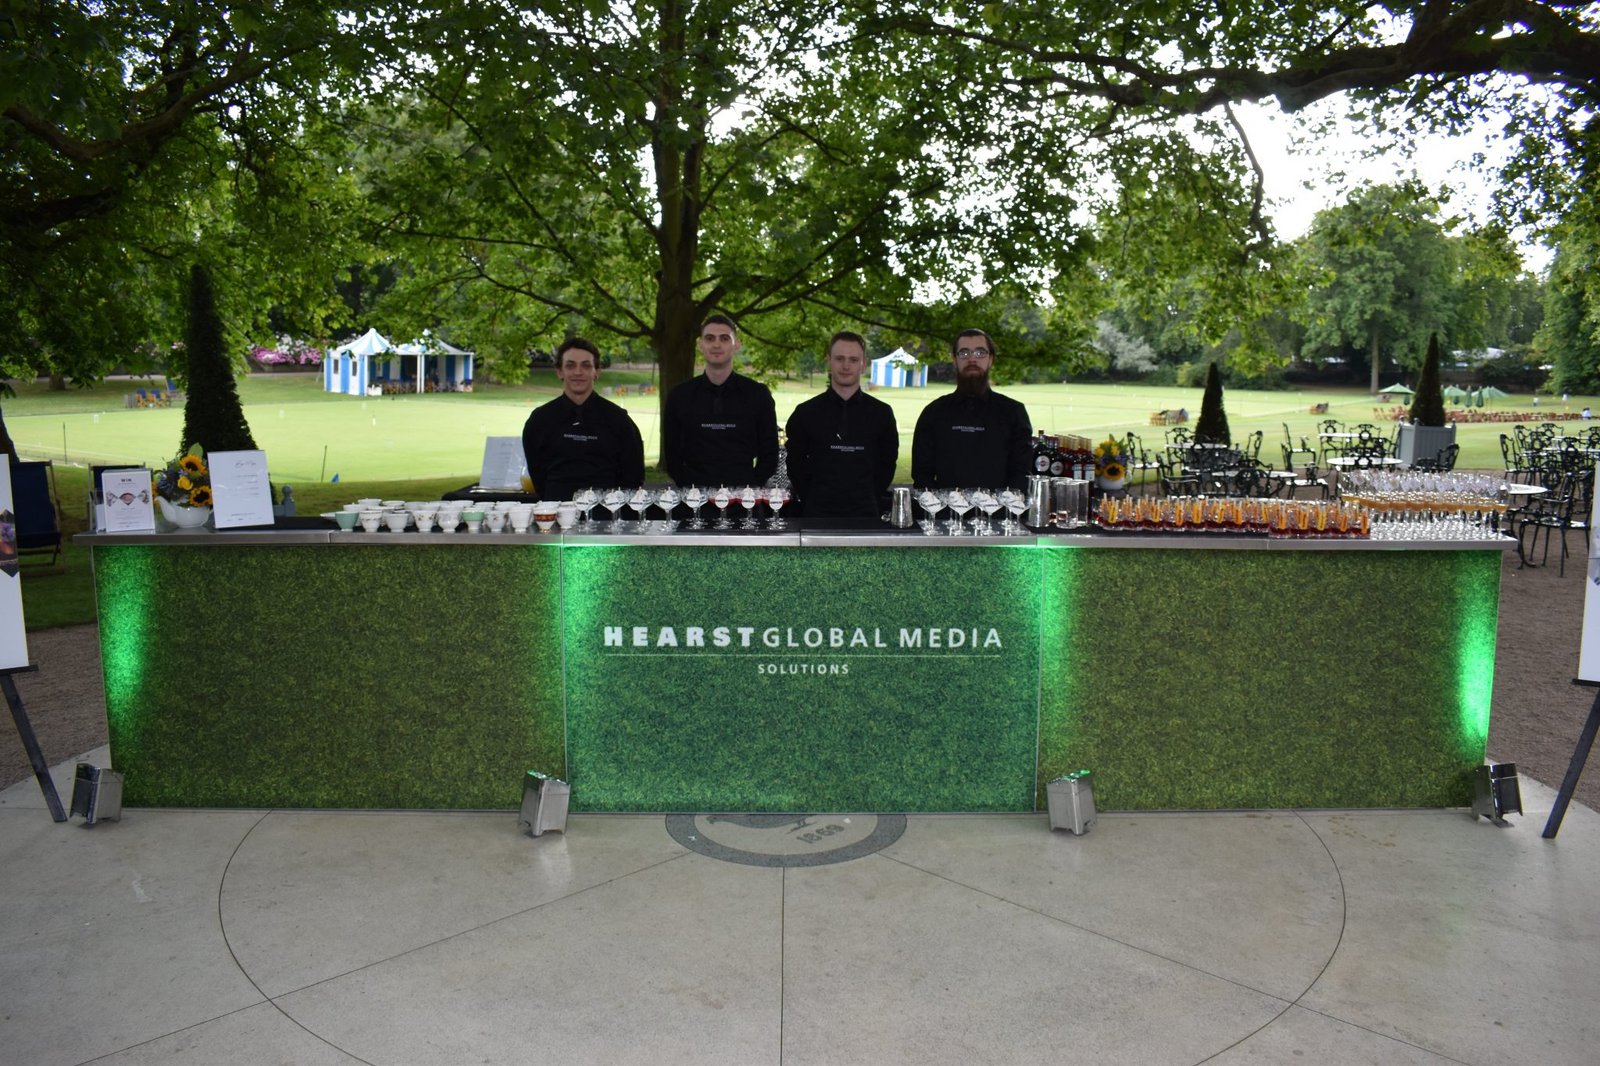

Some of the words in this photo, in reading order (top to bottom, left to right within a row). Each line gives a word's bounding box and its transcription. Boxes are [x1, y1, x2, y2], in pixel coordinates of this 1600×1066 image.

[604, 626, 754, 647] HEARST
[763, 627, 887, 648] GLOBAL
[900, 627, 1002, 648] MEDIA
[758, 663, 849, 675] SOLUTIONS
